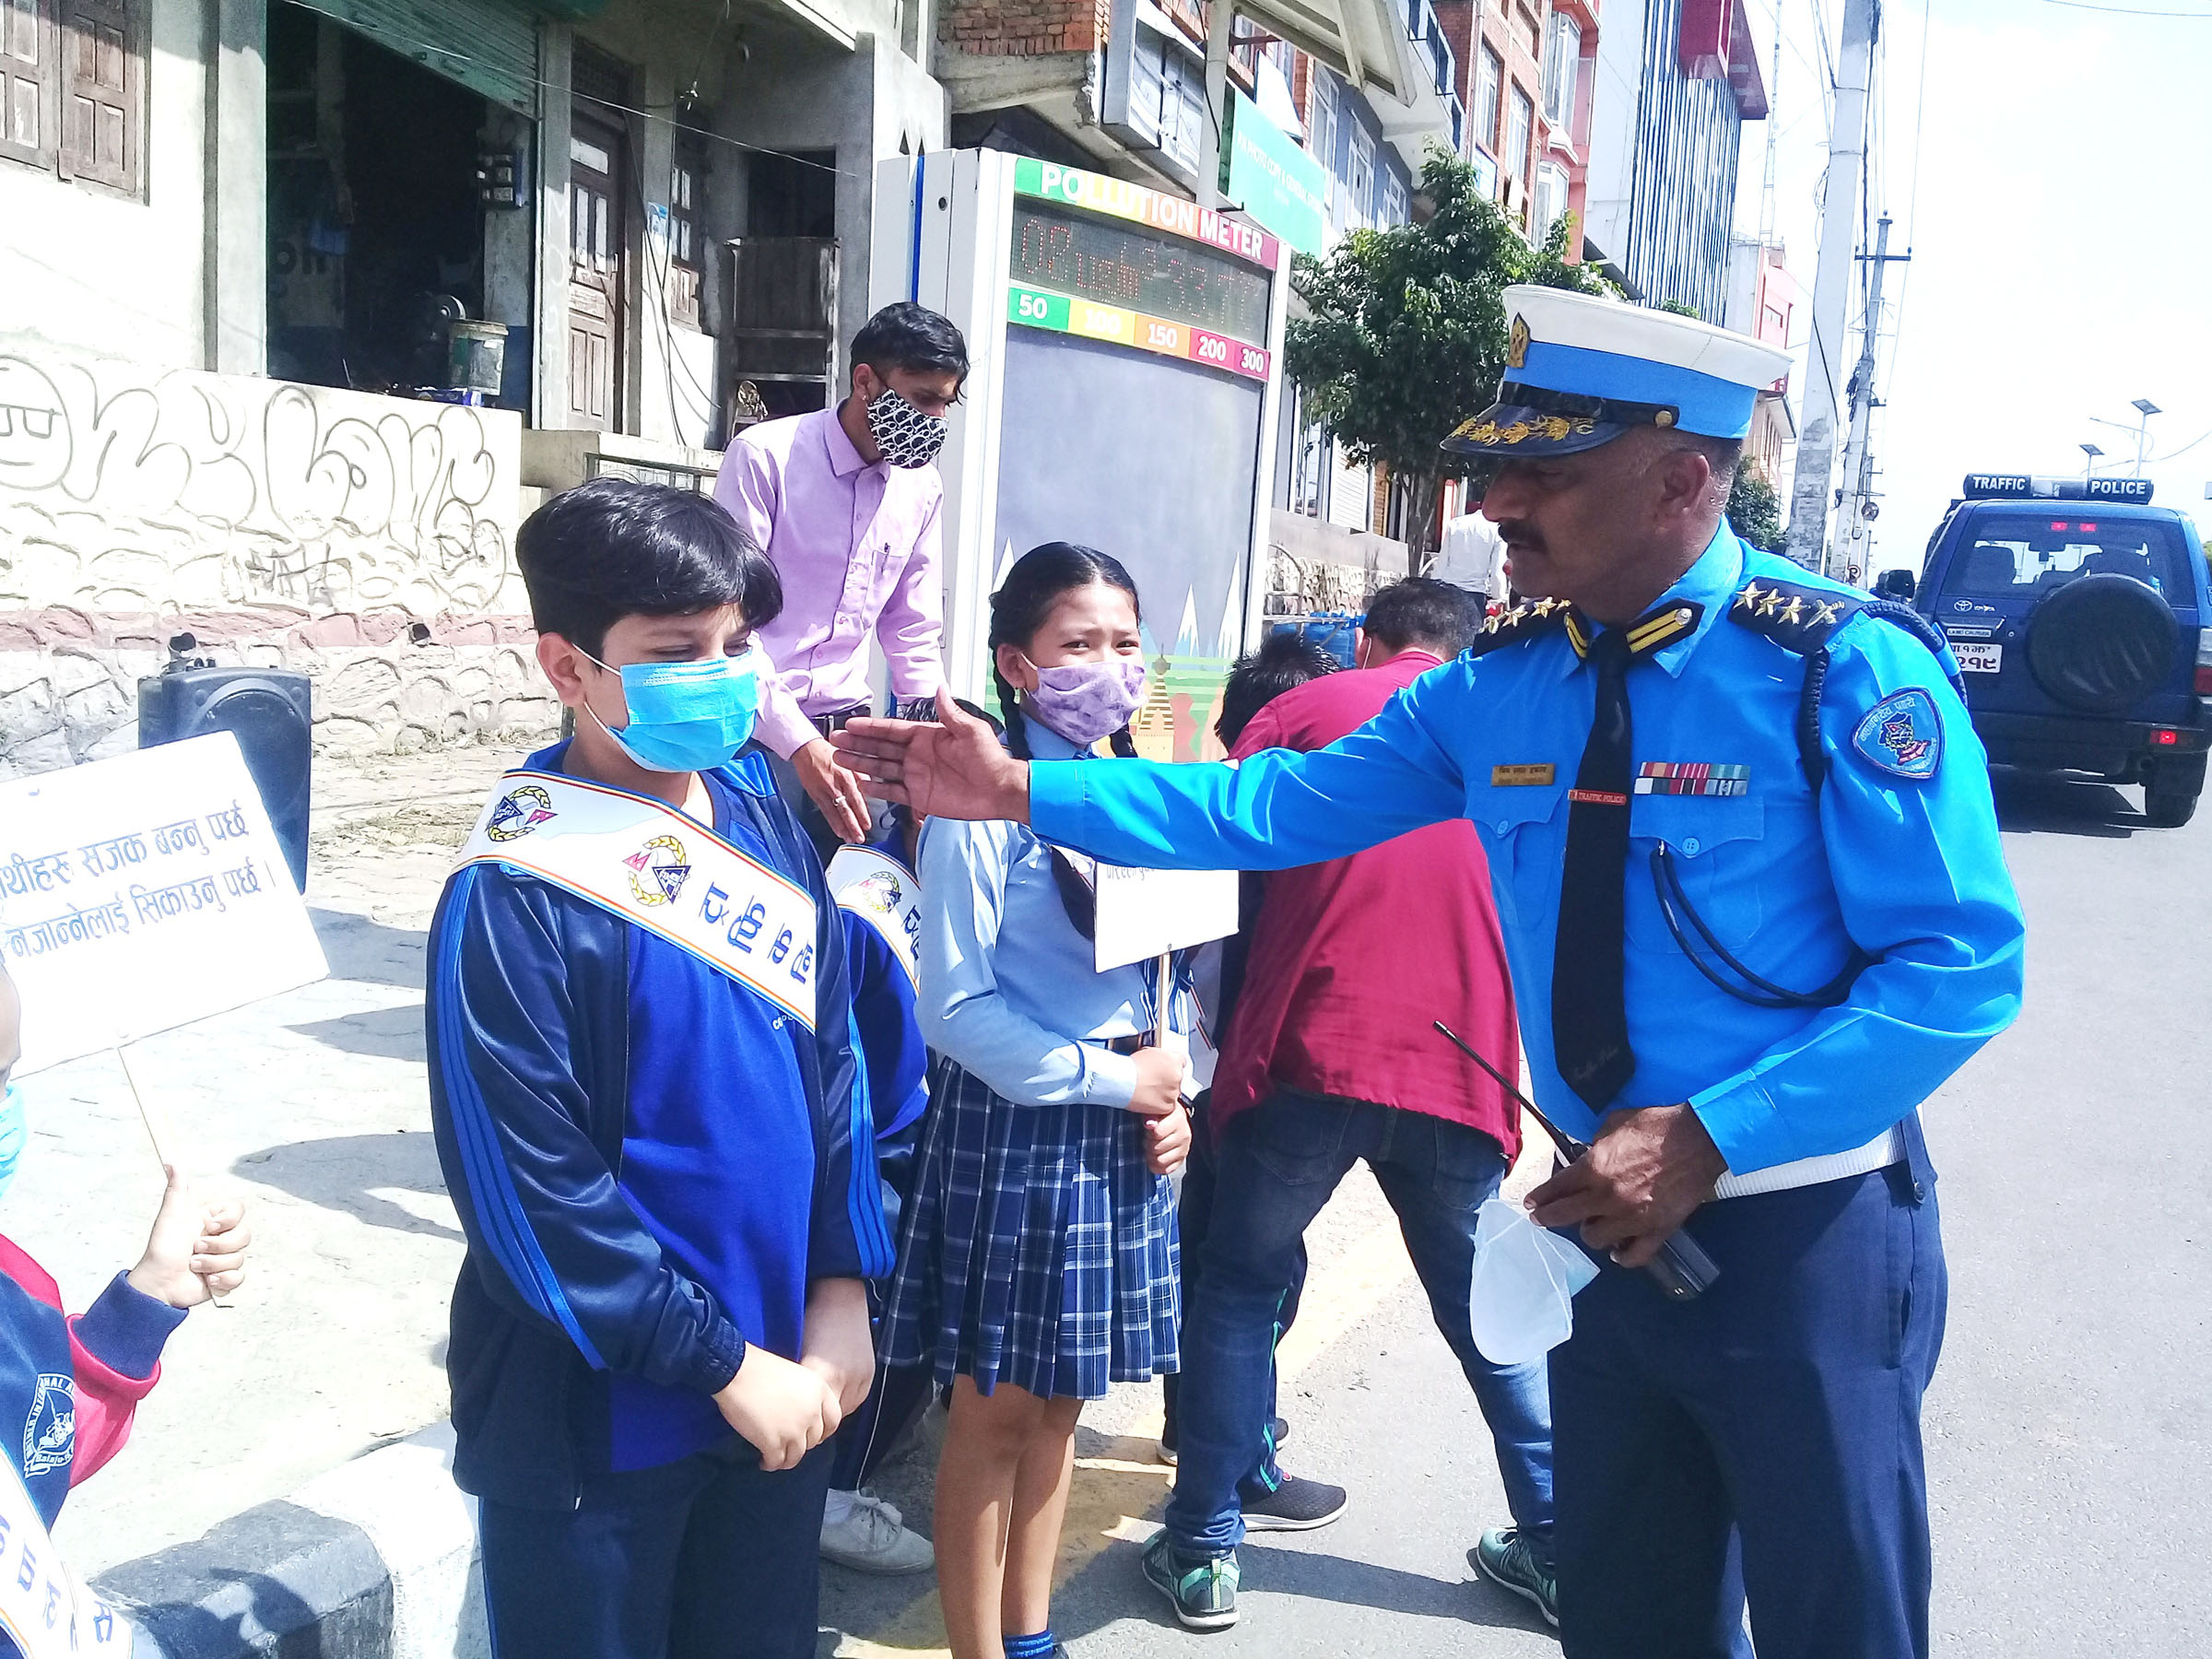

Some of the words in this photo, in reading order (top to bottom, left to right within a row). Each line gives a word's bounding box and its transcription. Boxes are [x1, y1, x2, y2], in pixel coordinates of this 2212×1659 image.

[1040, 163, 1194, 234] POLLUTION
[1199, 208, 1264, 261] METER
[1018, 293, 1048, 319] 50
[1085, 308, 1122, 335] 100
[1147, 323, 1178, 349] 150
[1197, 335, 1228, 362] 200
[1241, 347, 1265, 374] 300
[1971, 476, 2026, 491] TRAFFIC
[2090, 480, 2147, 495] POLICE
[1579, 792, 1603, 801] TRAFFIC
[1604, 794, 1625, 804] POLICE
